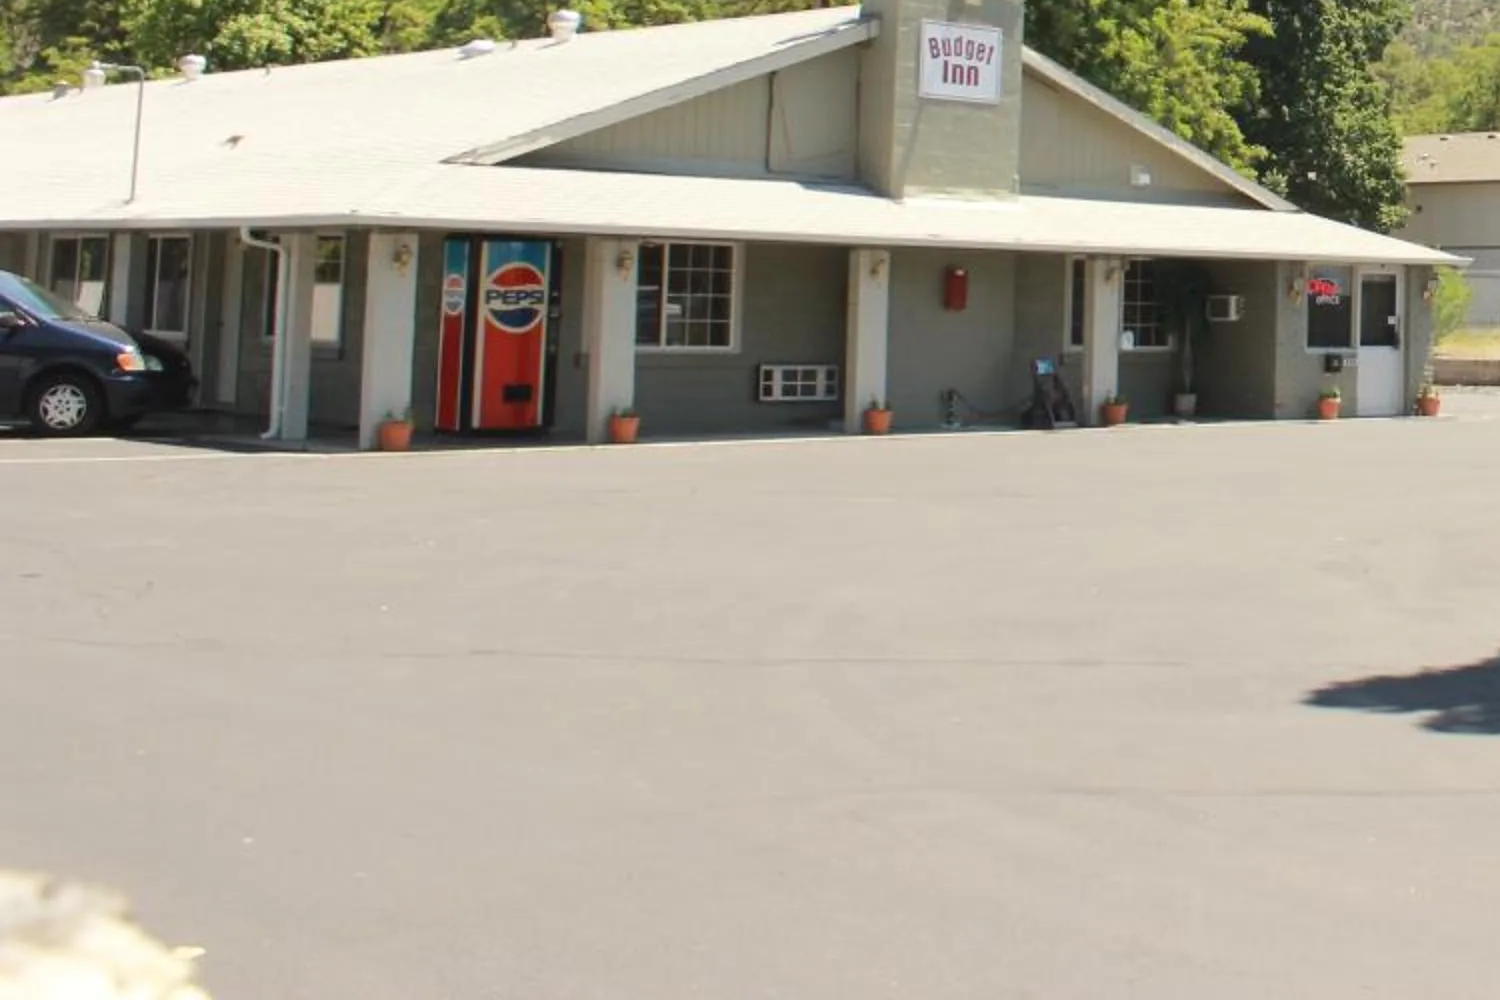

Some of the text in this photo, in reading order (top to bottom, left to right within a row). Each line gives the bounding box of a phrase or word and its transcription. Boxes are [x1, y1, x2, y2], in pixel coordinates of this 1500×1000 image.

[928, 36, 994, 65] Budget
[943, 60, 979, 86] Inn
[486, 289, 544, 305] PEPSI
